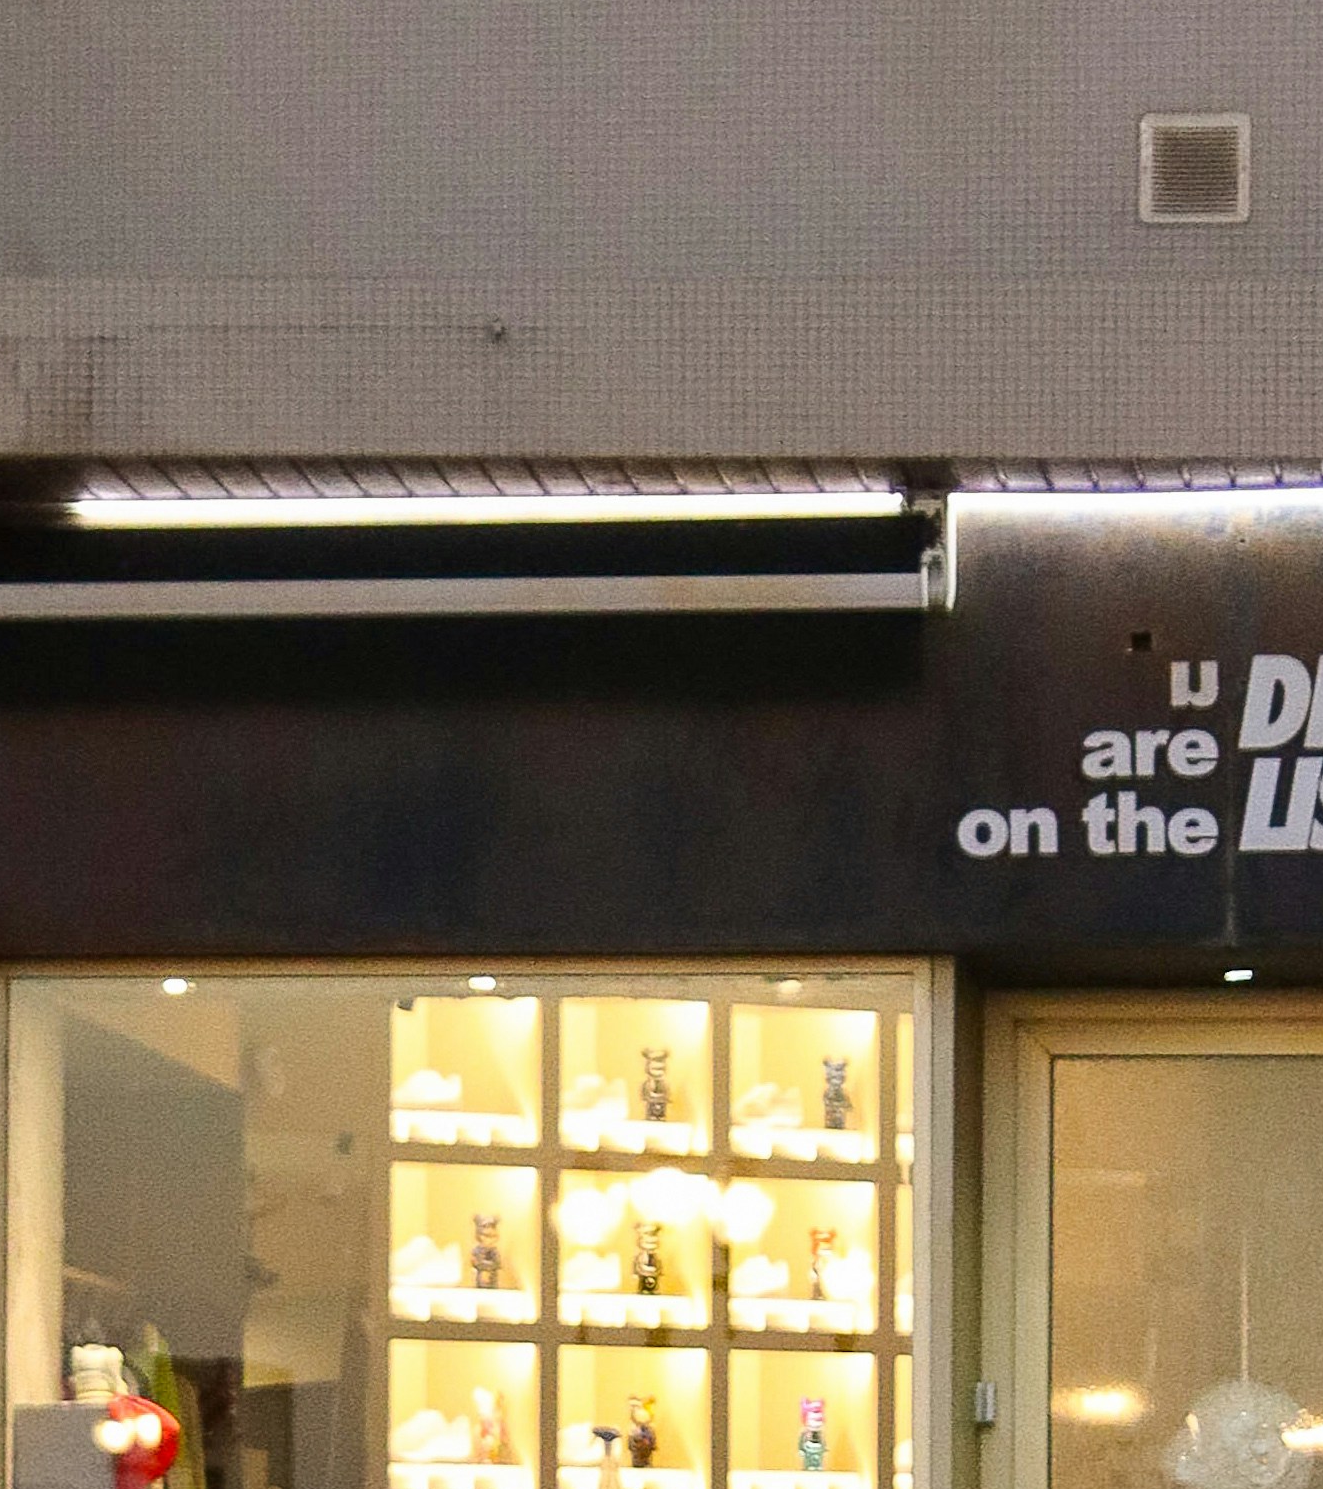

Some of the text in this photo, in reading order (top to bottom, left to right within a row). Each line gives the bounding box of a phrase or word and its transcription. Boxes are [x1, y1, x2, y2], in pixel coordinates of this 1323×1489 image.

[1170, 659, 1220, 708] u
[1081, 728, 1219, 779] are
[957, 791, 1219, 857] on the
